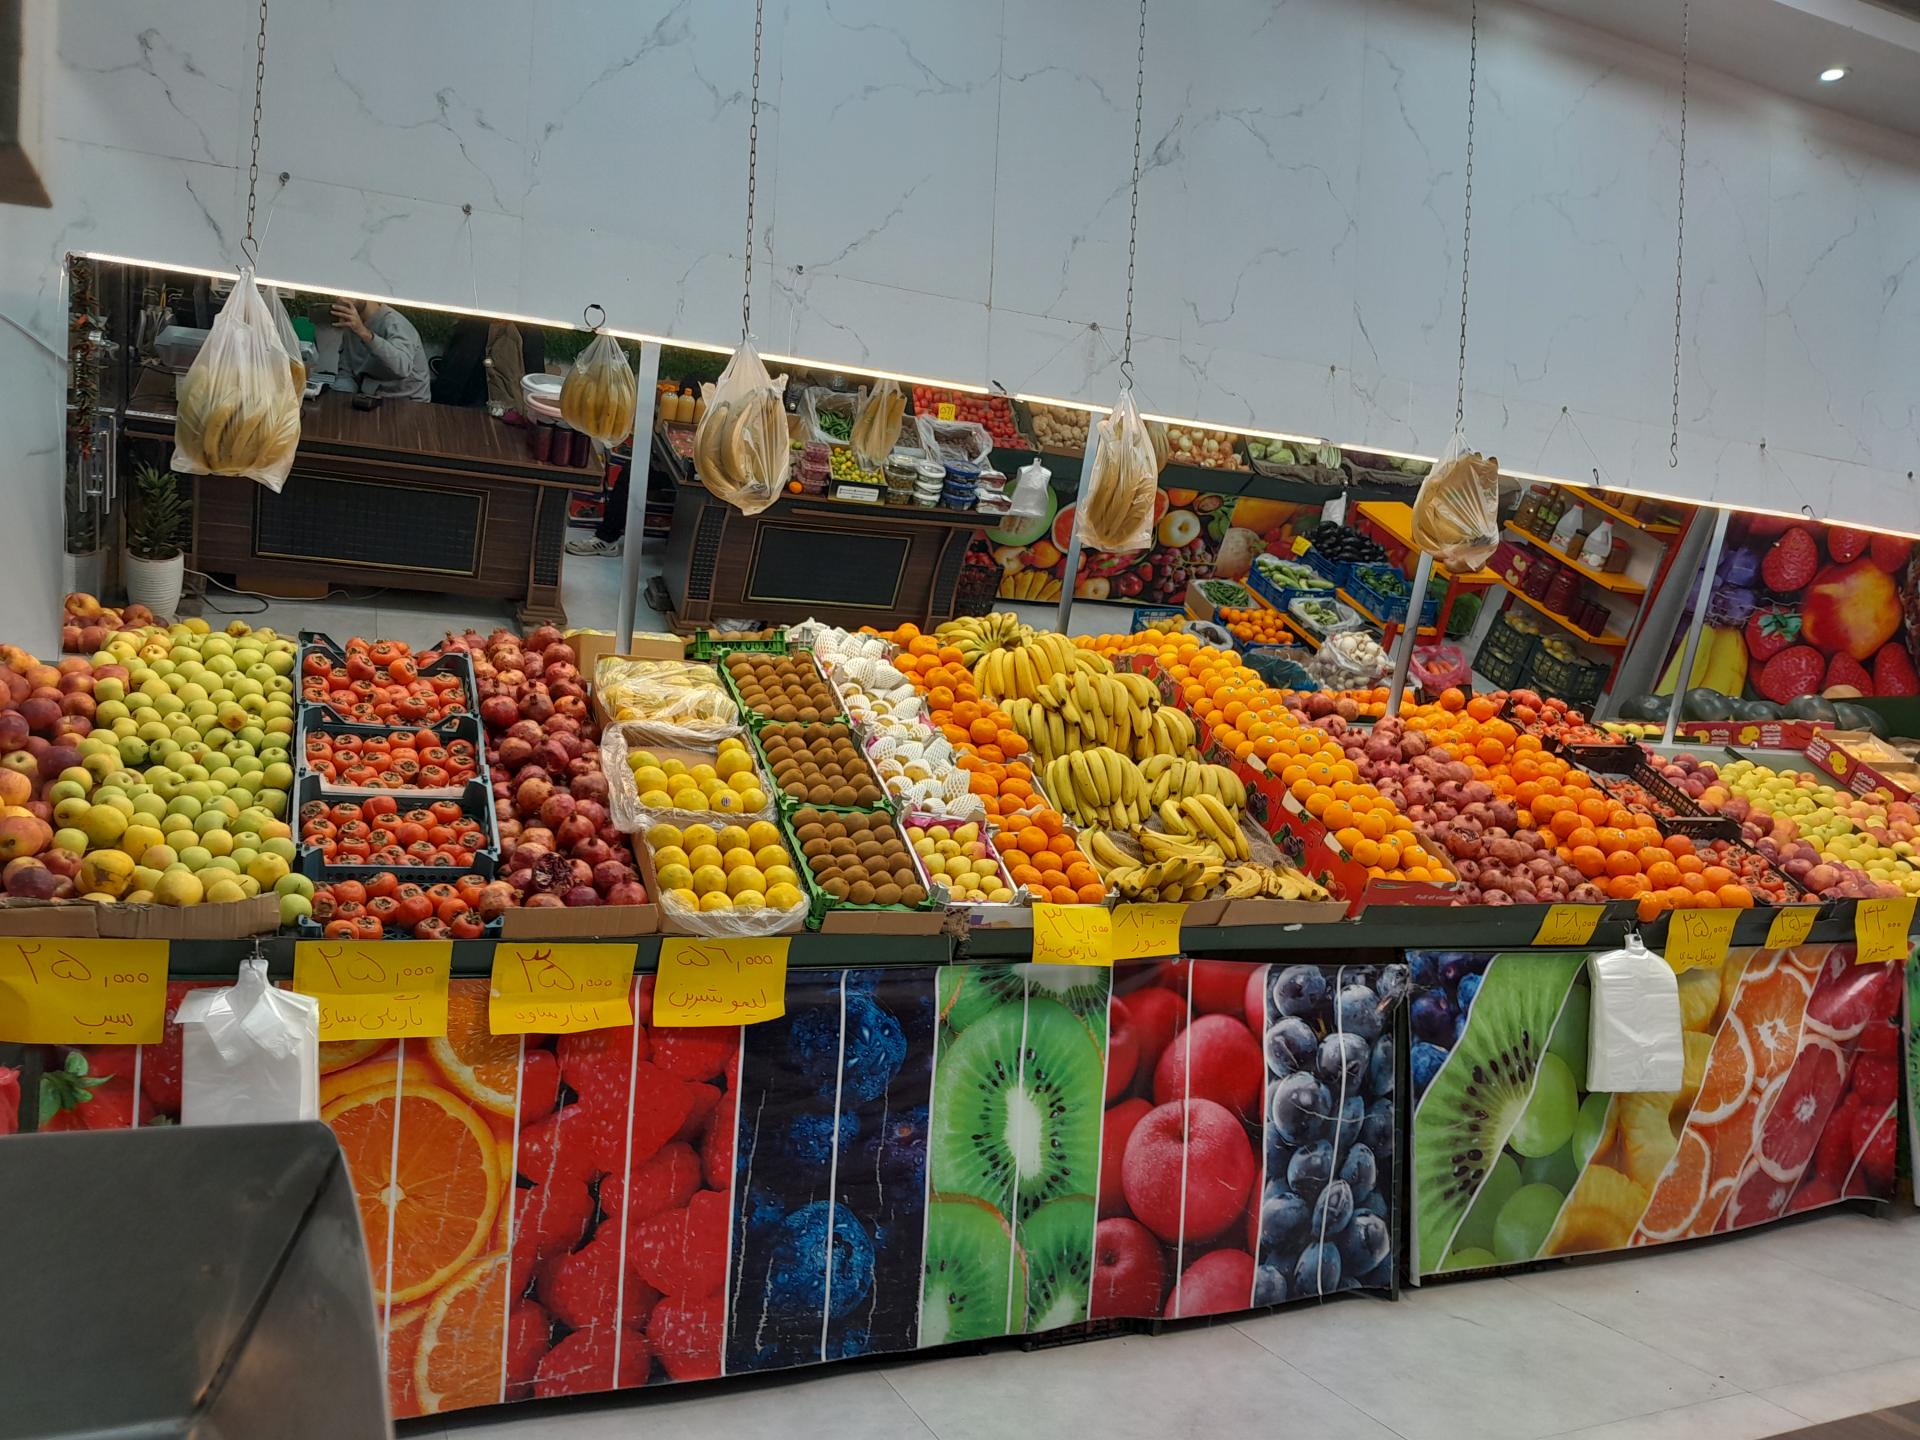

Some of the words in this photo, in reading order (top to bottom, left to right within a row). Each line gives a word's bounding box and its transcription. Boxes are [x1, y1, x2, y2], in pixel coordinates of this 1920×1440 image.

[1131, 933, 1167, 953] موز
[668, 983, 723, 1018] شیرین
[723, 988, 767, 1017] لیمو
[72, 1012, 135, 1036] سیب
[514, 1006, 558, 1024] ساوه
[559, 1003, 601, 1027] انار
